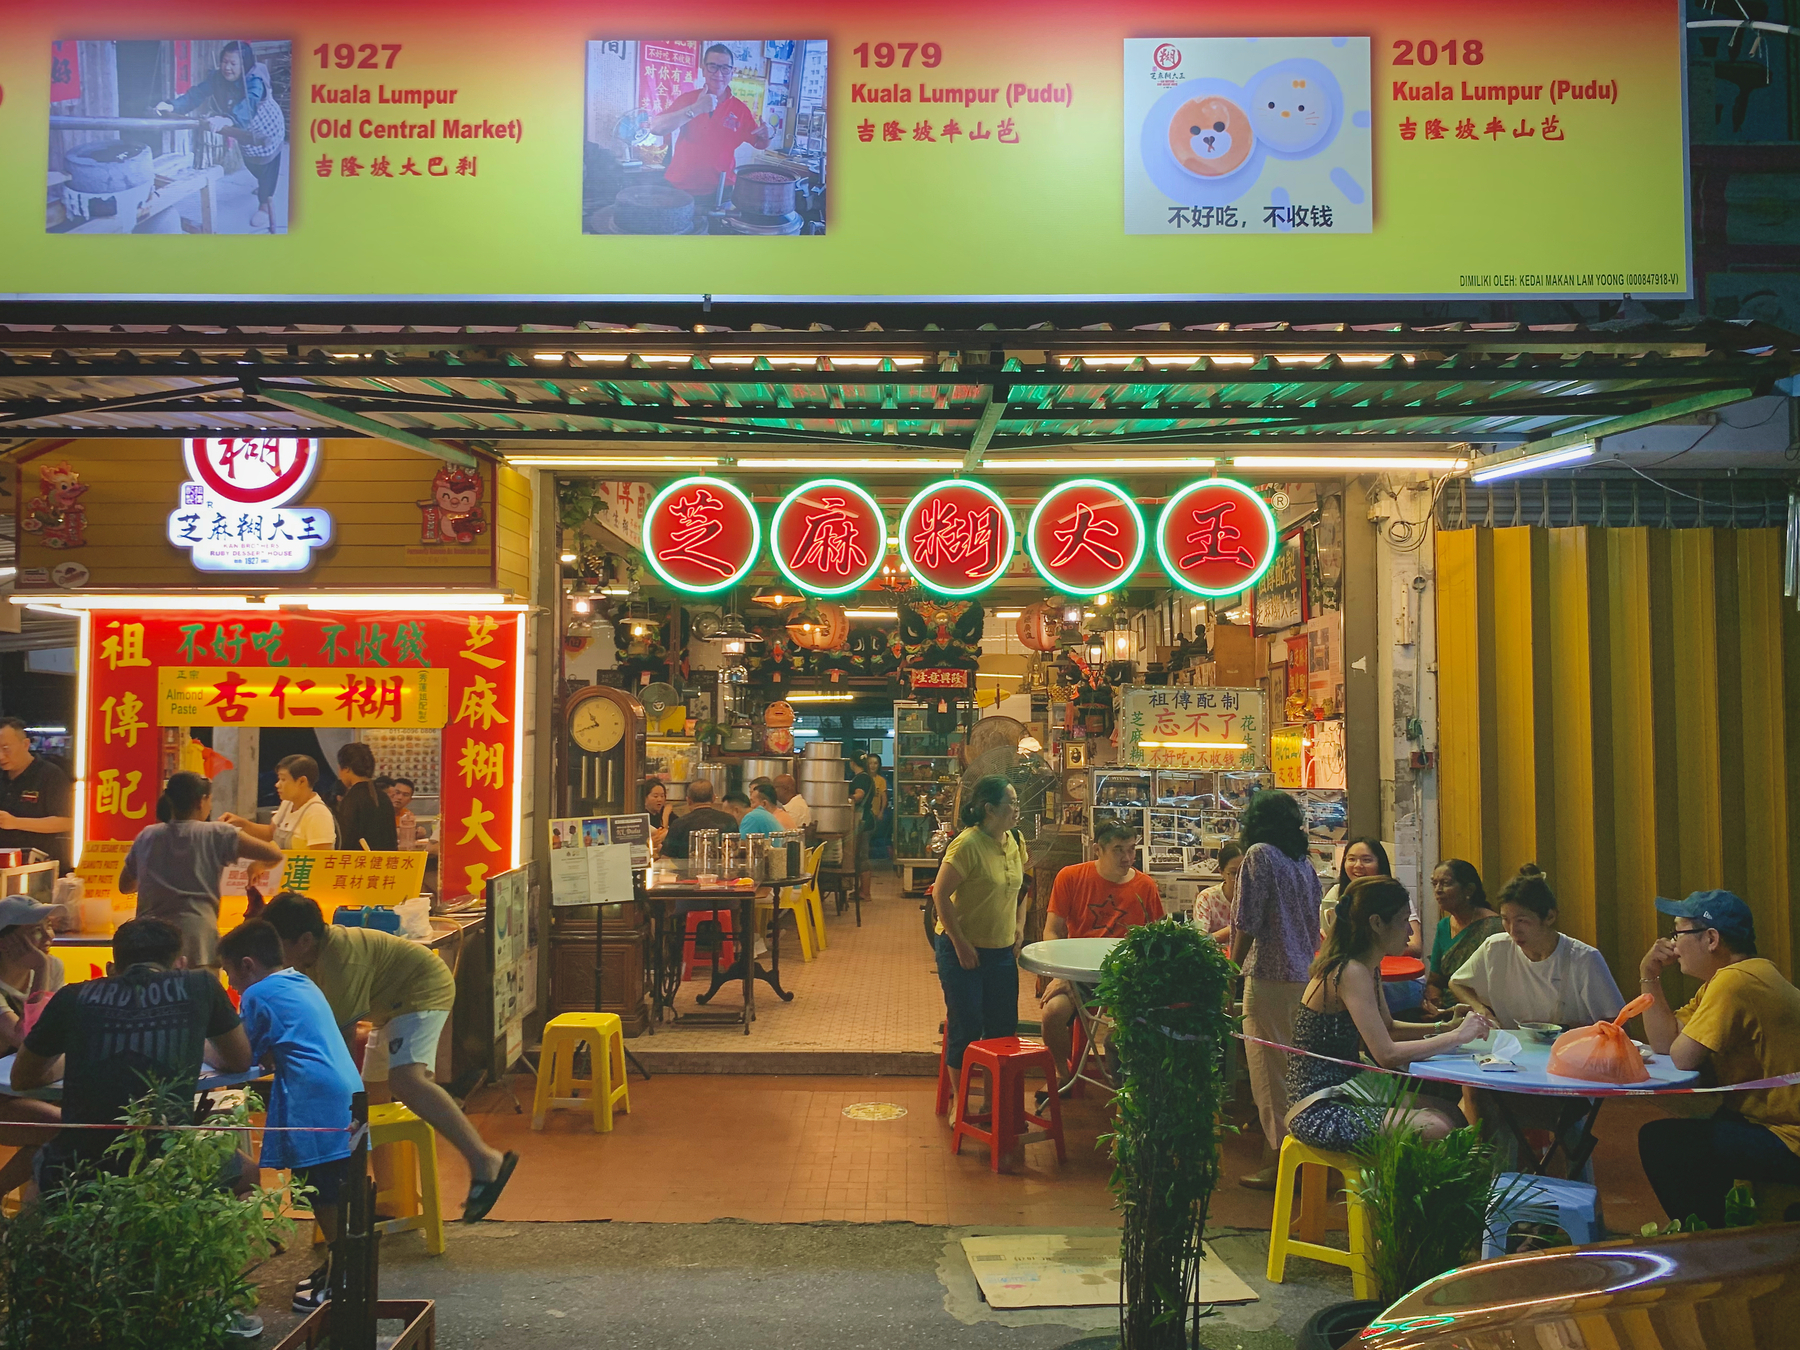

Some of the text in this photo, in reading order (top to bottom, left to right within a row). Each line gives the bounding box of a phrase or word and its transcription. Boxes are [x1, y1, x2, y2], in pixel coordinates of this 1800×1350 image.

[313, 43, 402, 69] 1927
[853, 42, 942, 68] 1979
[1392, 39, 1484, 66] 2018
[311, 84, 458, 109] Kuala Lumpur
[641, 96, 674, 112] 芝麻
[851, 83, 1073, 108] Kuala Lumpur (Pudu)
[1392, 79, 1618, 105] Kuala Lumpur (Pudu)
[310, 118, 523, 143] (Old Central Market)
[856, 117, 1020, 144] 吉隆坡半山芭
[1398, 115, 1565, 142] 吉隆坡半山芭
[1459, 273, 1679, 287] DIMILIKI OLEH: KEDAI MAKAN LAM YOONG (000847918-V)
[176, 511, 323, 543] 芝麻糊大王
[658, 488, 1256, 579] 芝麻糊大王
[176, 621, 432, 669] 不好吃 不收錢
[176, 670, 200, 680] 正宗
[916, 671, 961, 684] 生意興隆
[166, 688, 204, 700] Almond
[203, 671, 404, 723] 杏仁糊
[1148, 690, 1240, 711] 祖傳配制
[170, 703, 198, 715] Paste
[1129, 710, 1146, 763] 芝麻糊
[1152, 707, 1238, 740] 忘不了
[1240, 715, 1257, 766] 花生糊
[453, 614, 509, 900] 芝麻糊大王
[104, 860, 119, 869] PASTE
[281, 855, 316, 891] 蓮
[324, 854, 415, 870] 古早保健糖水
[98, 875, 113, 883] PASTE
[332, 874, 396, 890] 真材實料
[77, 977, 188, 1008] HARD ROCK
